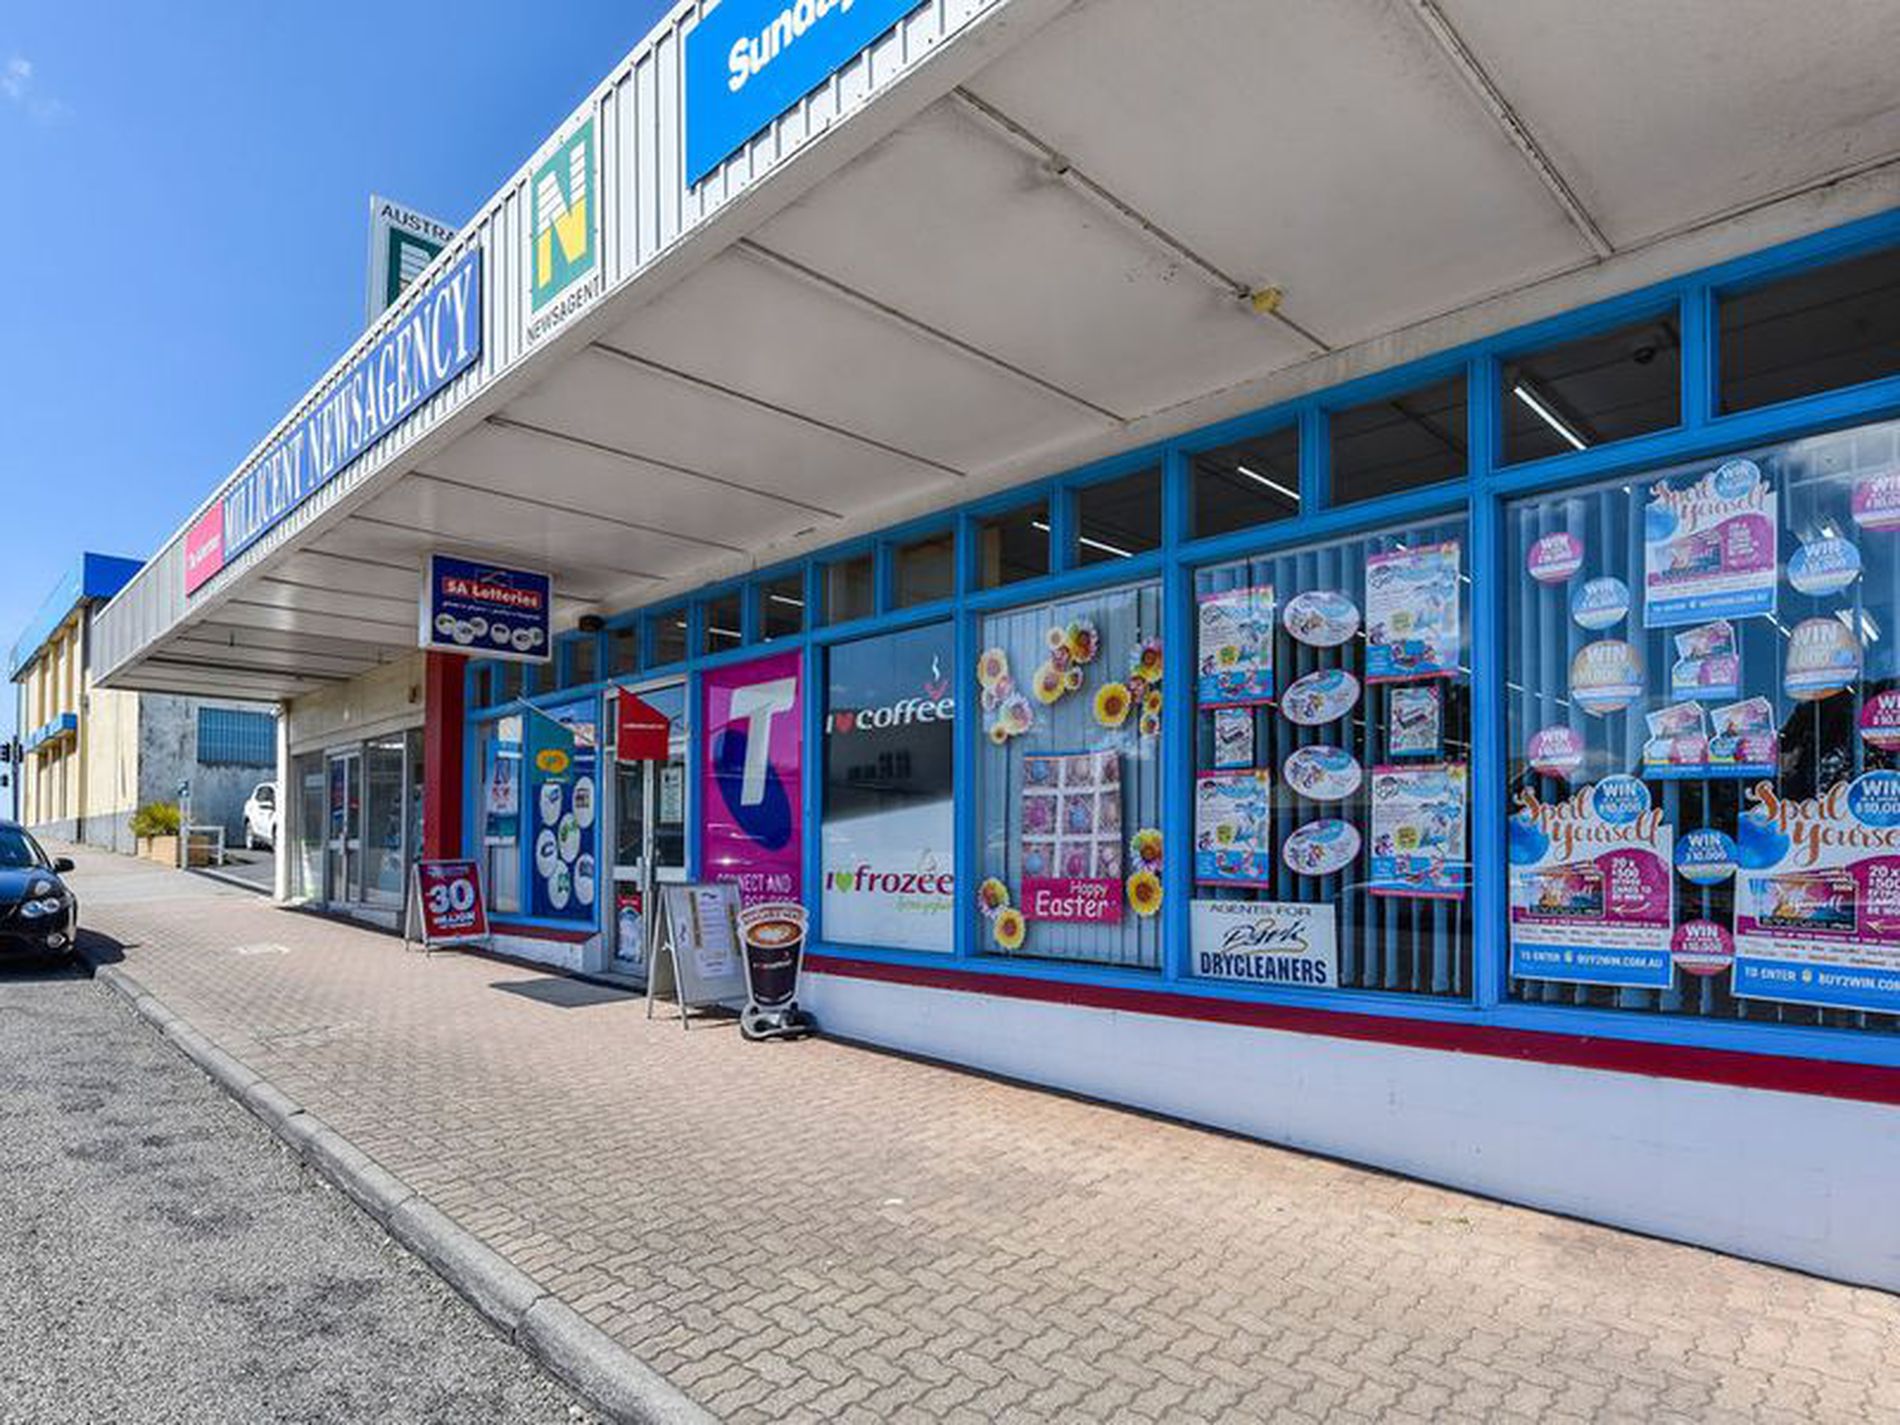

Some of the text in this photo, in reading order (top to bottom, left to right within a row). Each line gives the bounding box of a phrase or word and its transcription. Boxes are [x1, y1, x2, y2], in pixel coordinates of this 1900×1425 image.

[526, 275, 600, 346] NEWSAGENT
[223, 262, 472, 558] MILLICENT NEWSAGENCY
[446, 579, 539, 609] SA Lotteries
[855, 697, 955, 730] coffee
[1603, 783, 1638, 797] WIN
[1745, 780, 1849, 833] Spoil
[1688, 834, 1721, 847] WIN
[1035, 889, 1108, 918] Easter
[1070, 880, 1109, 899] Happy
[1210, 903, 1312, 916] AGENTS FOR
[1686, 924, 1719, 938] WIN
[1200, 952, 1328, 984] DRYCLEANERS
[1760, 968, 1797, 982] ENTER
